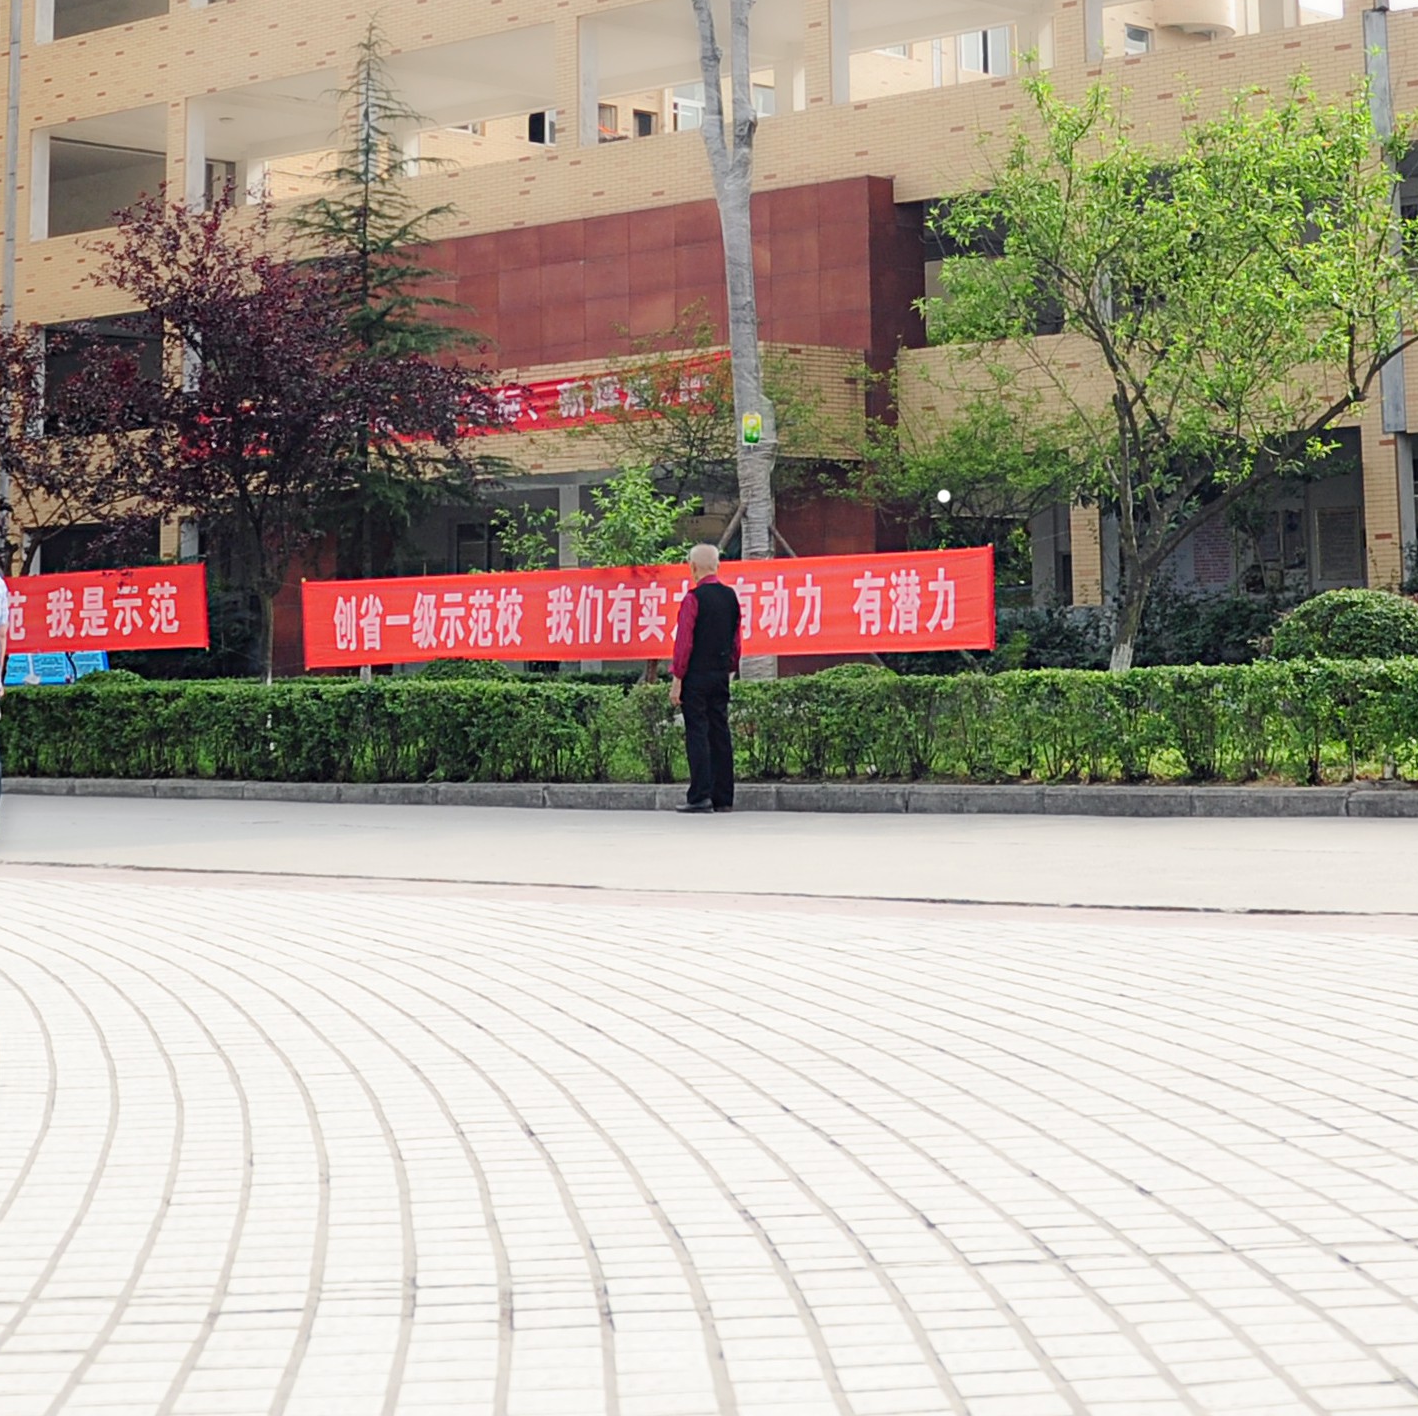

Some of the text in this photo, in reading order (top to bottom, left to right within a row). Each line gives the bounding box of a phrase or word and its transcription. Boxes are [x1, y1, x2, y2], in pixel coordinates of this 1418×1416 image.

[46, 580, 180, 639] 我是示范
[333, 587, 524, 652] 创省一级示范校
[727, 573, 822, 640] 有动力
[852, 567, 956, 636] 有潜力
